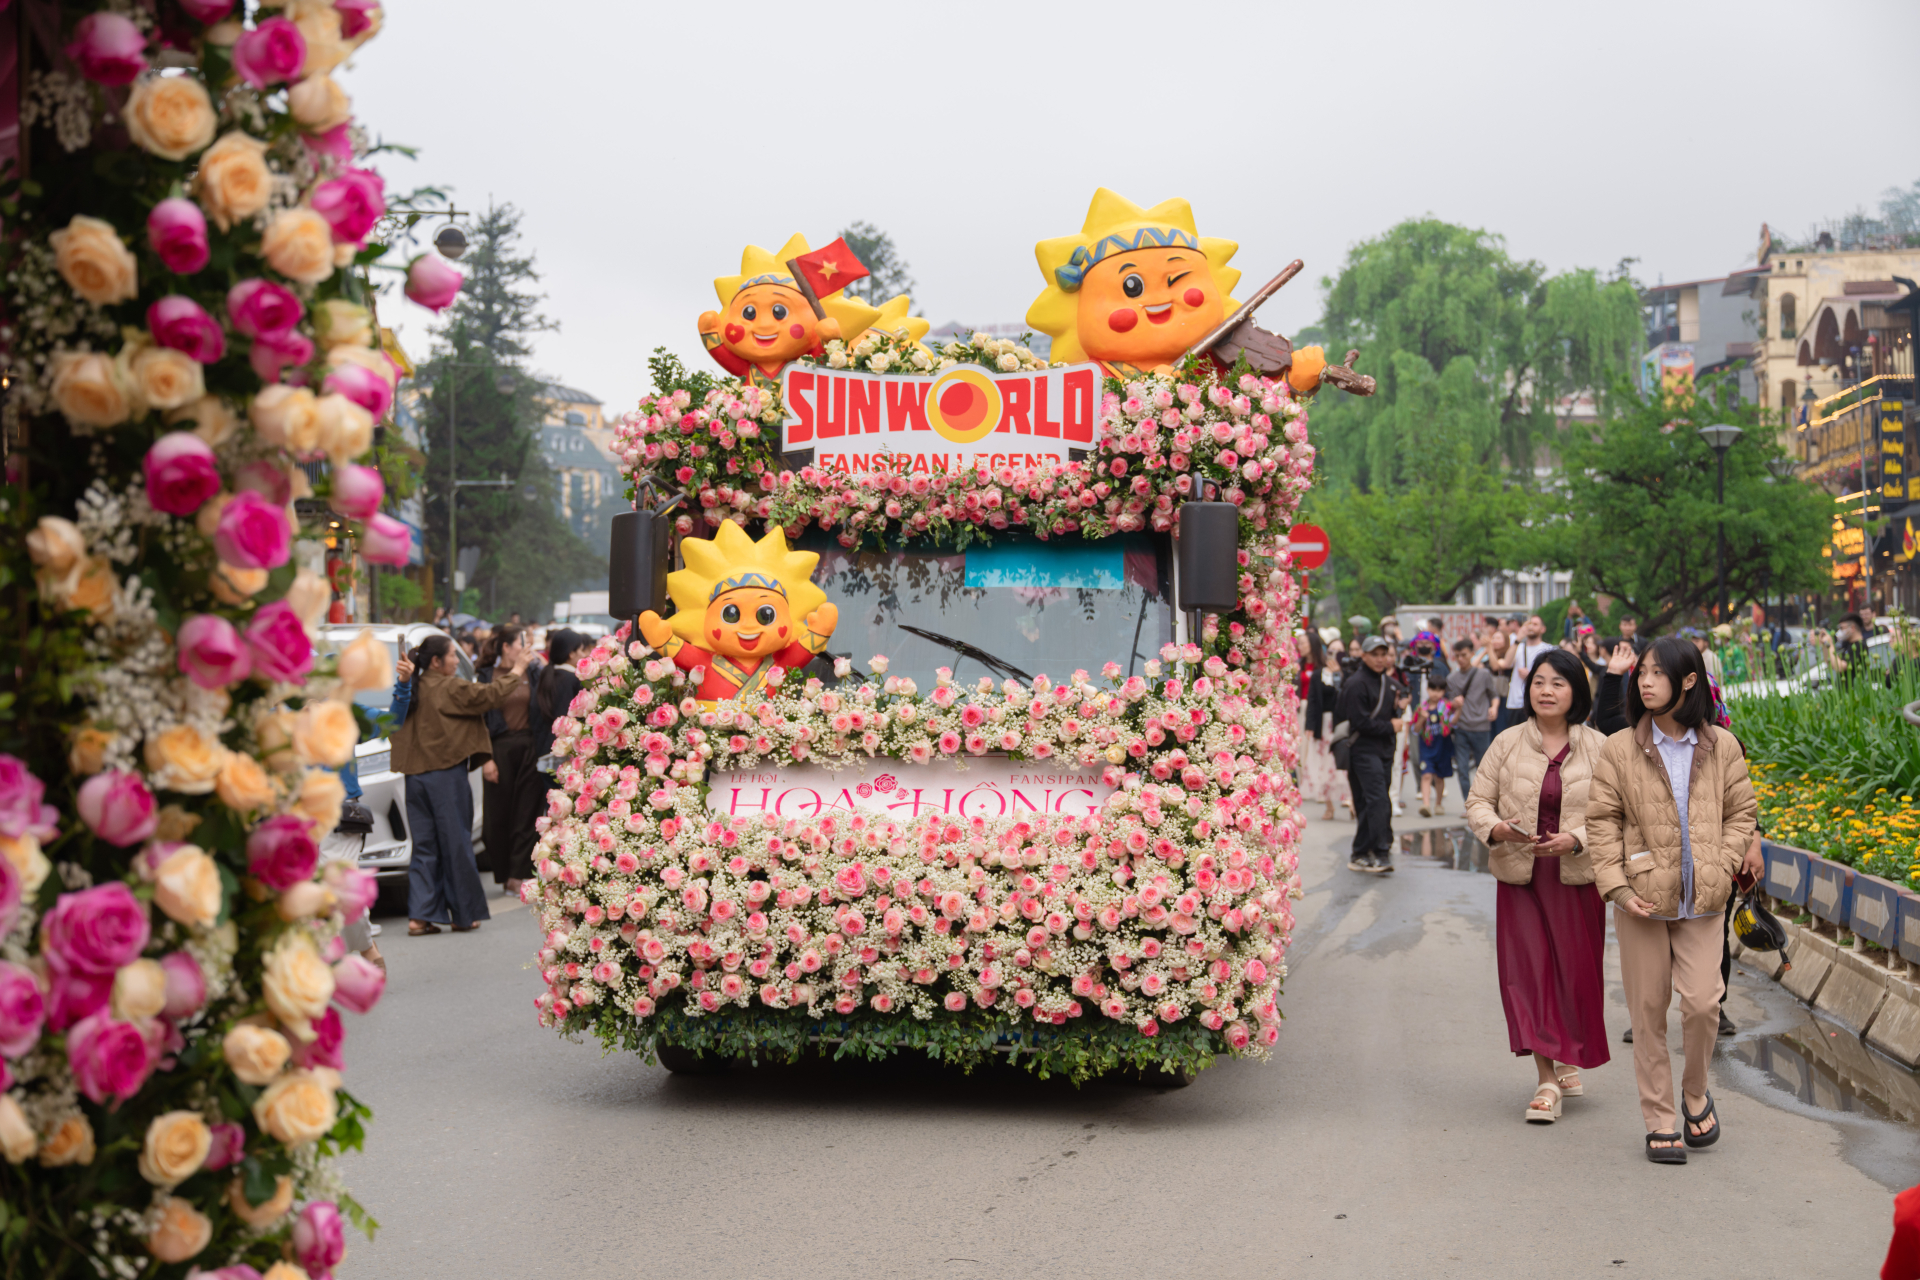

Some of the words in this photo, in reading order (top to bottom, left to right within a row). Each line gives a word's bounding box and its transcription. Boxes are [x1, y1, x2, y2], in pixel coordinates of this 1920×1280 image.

[819, 453, 949, 475] FANSIPAN
[1009, 774, 1100, 785] FANSIPAN
[730, 786, 858, 819] HOA
